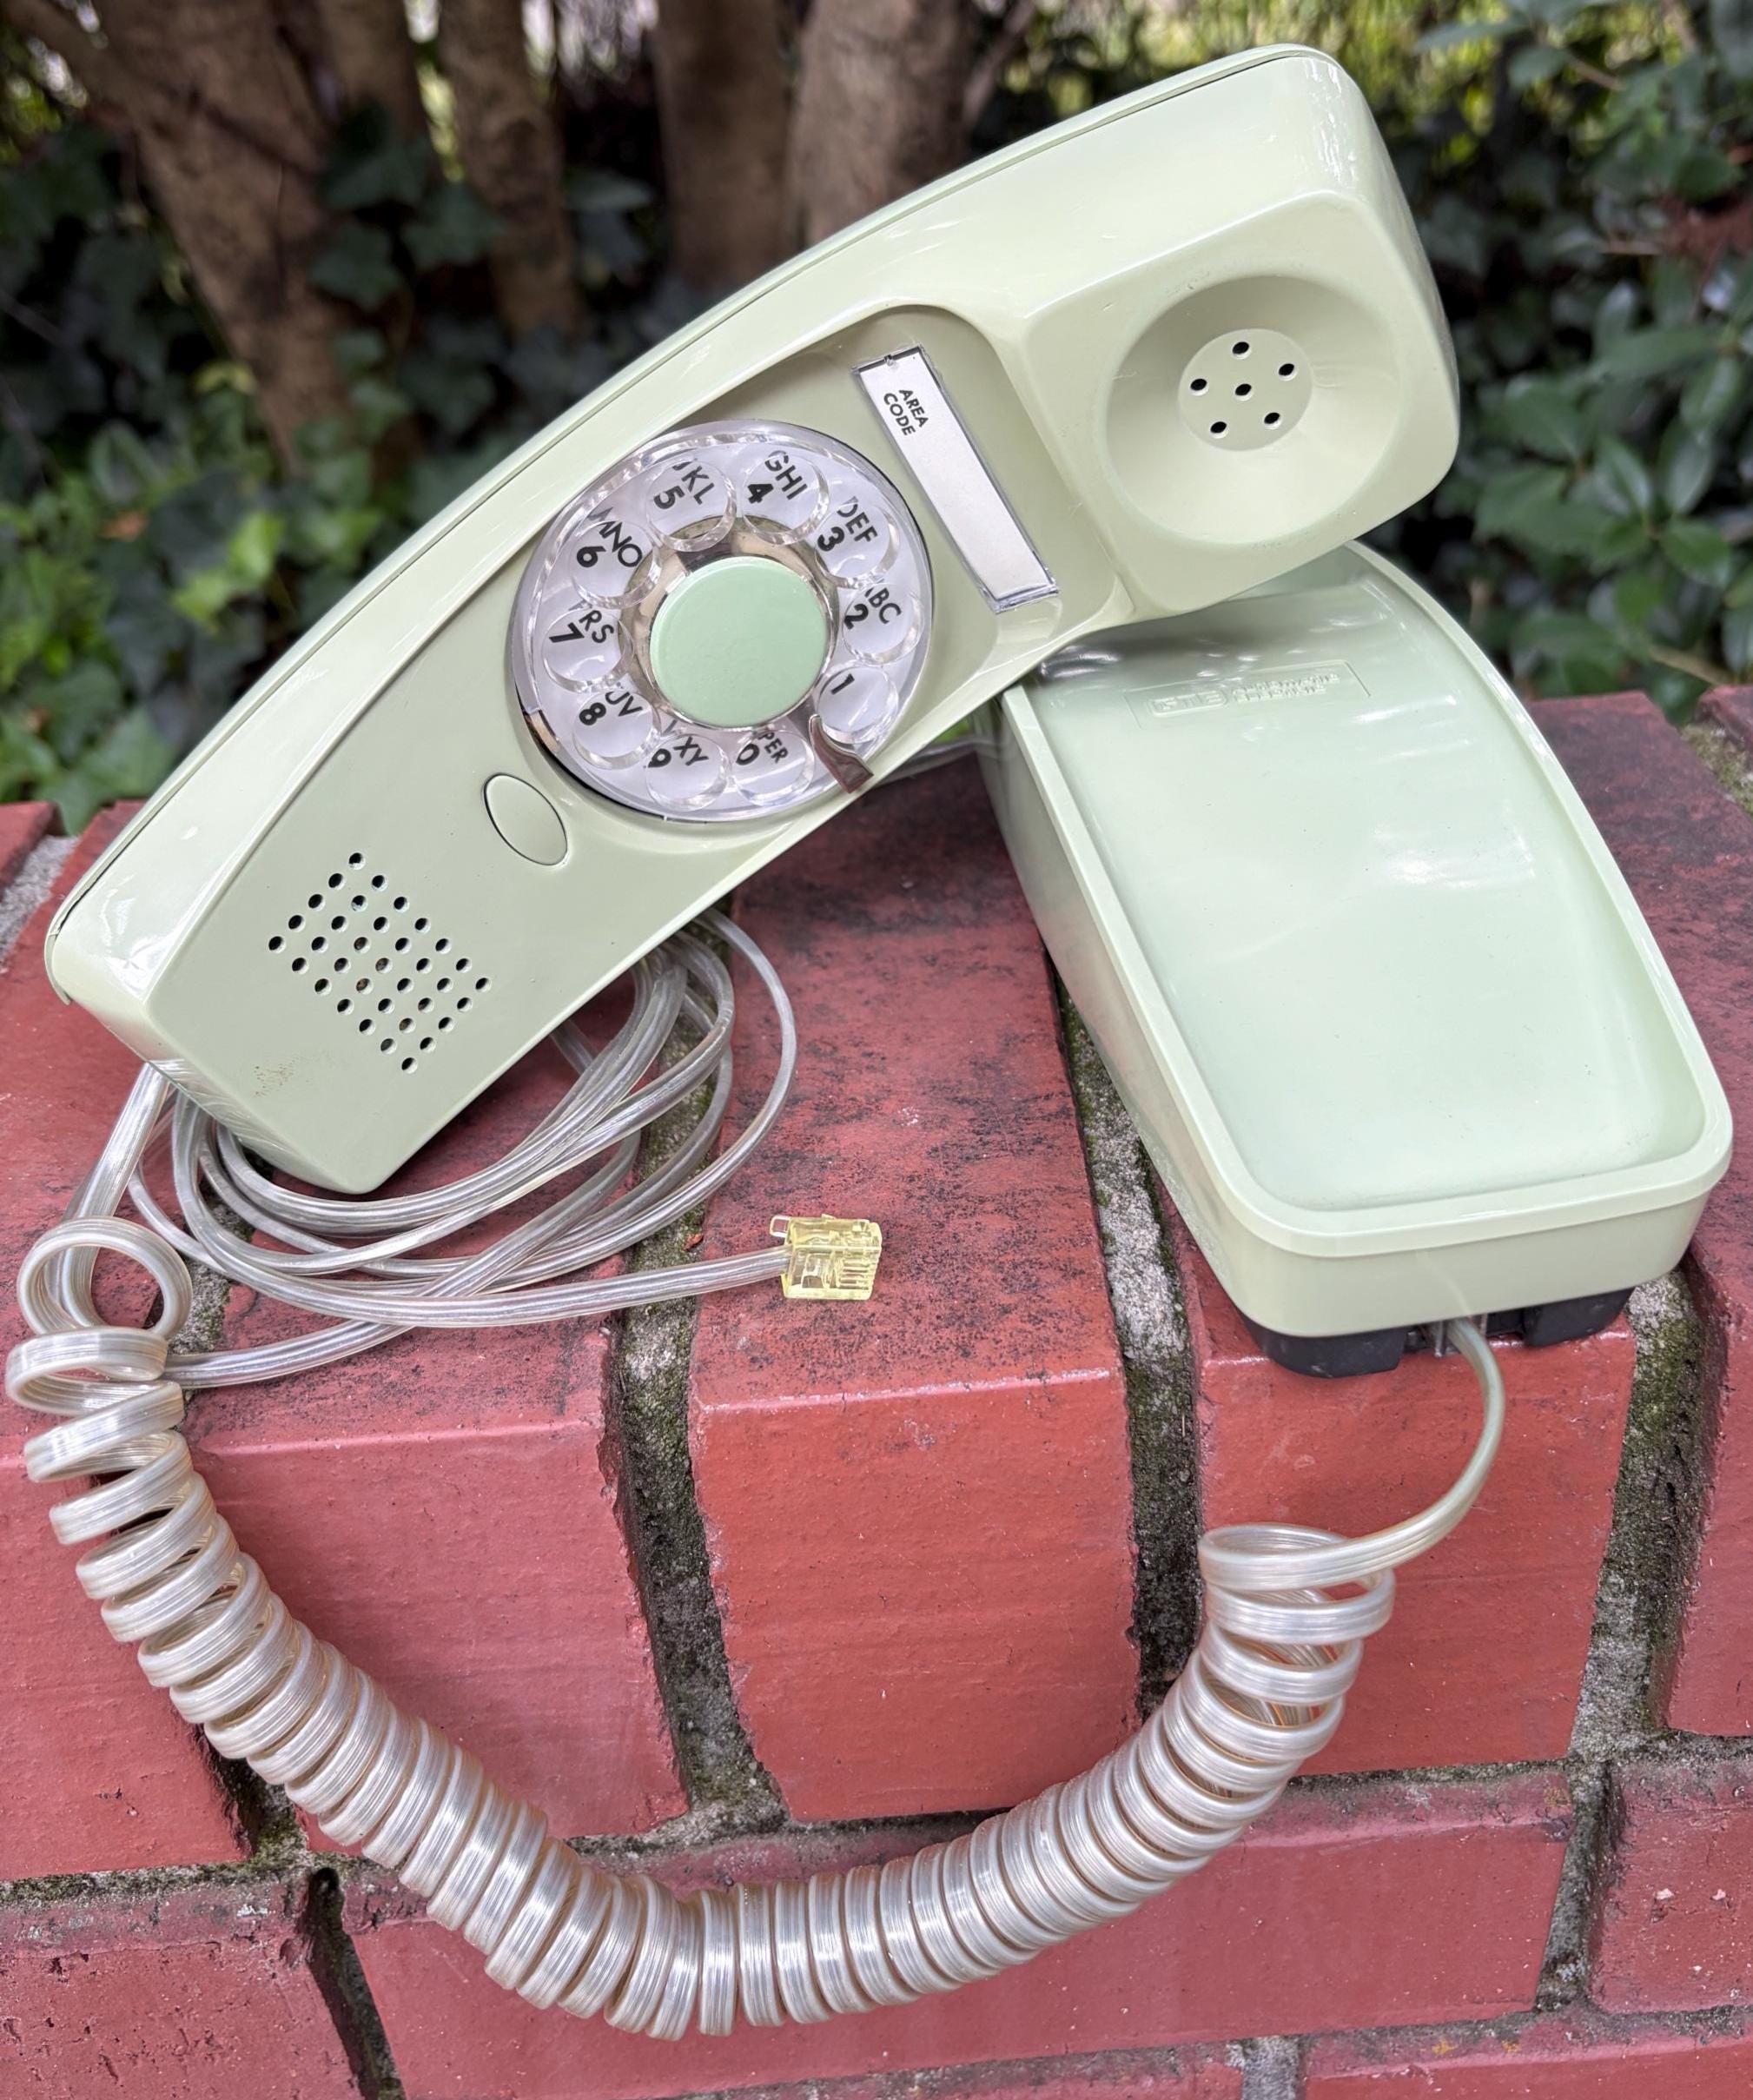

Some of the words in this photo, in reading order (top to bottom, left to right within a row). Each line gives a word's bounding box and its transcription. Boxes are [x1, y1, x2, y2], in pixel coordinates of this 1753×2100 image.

[883, 393, 916, 435] CODE
[898, 389, 929, 427] AREA
[764, 450, 808, 500] GHI
[653, 485, 685, 509] 5
[747, 483, 773, 504] 4
[817, 527, 845, 552] 3
[576, 546, 606, 568] 6
[843, 603, 869, 630] 2
[548, 622, 585, 643] 7
[830, 673, 855, 695] 1
[579, 702, 606, 725] 8
[648, 748, 671, 768] 9
[757, 732, 788, 764] PER
